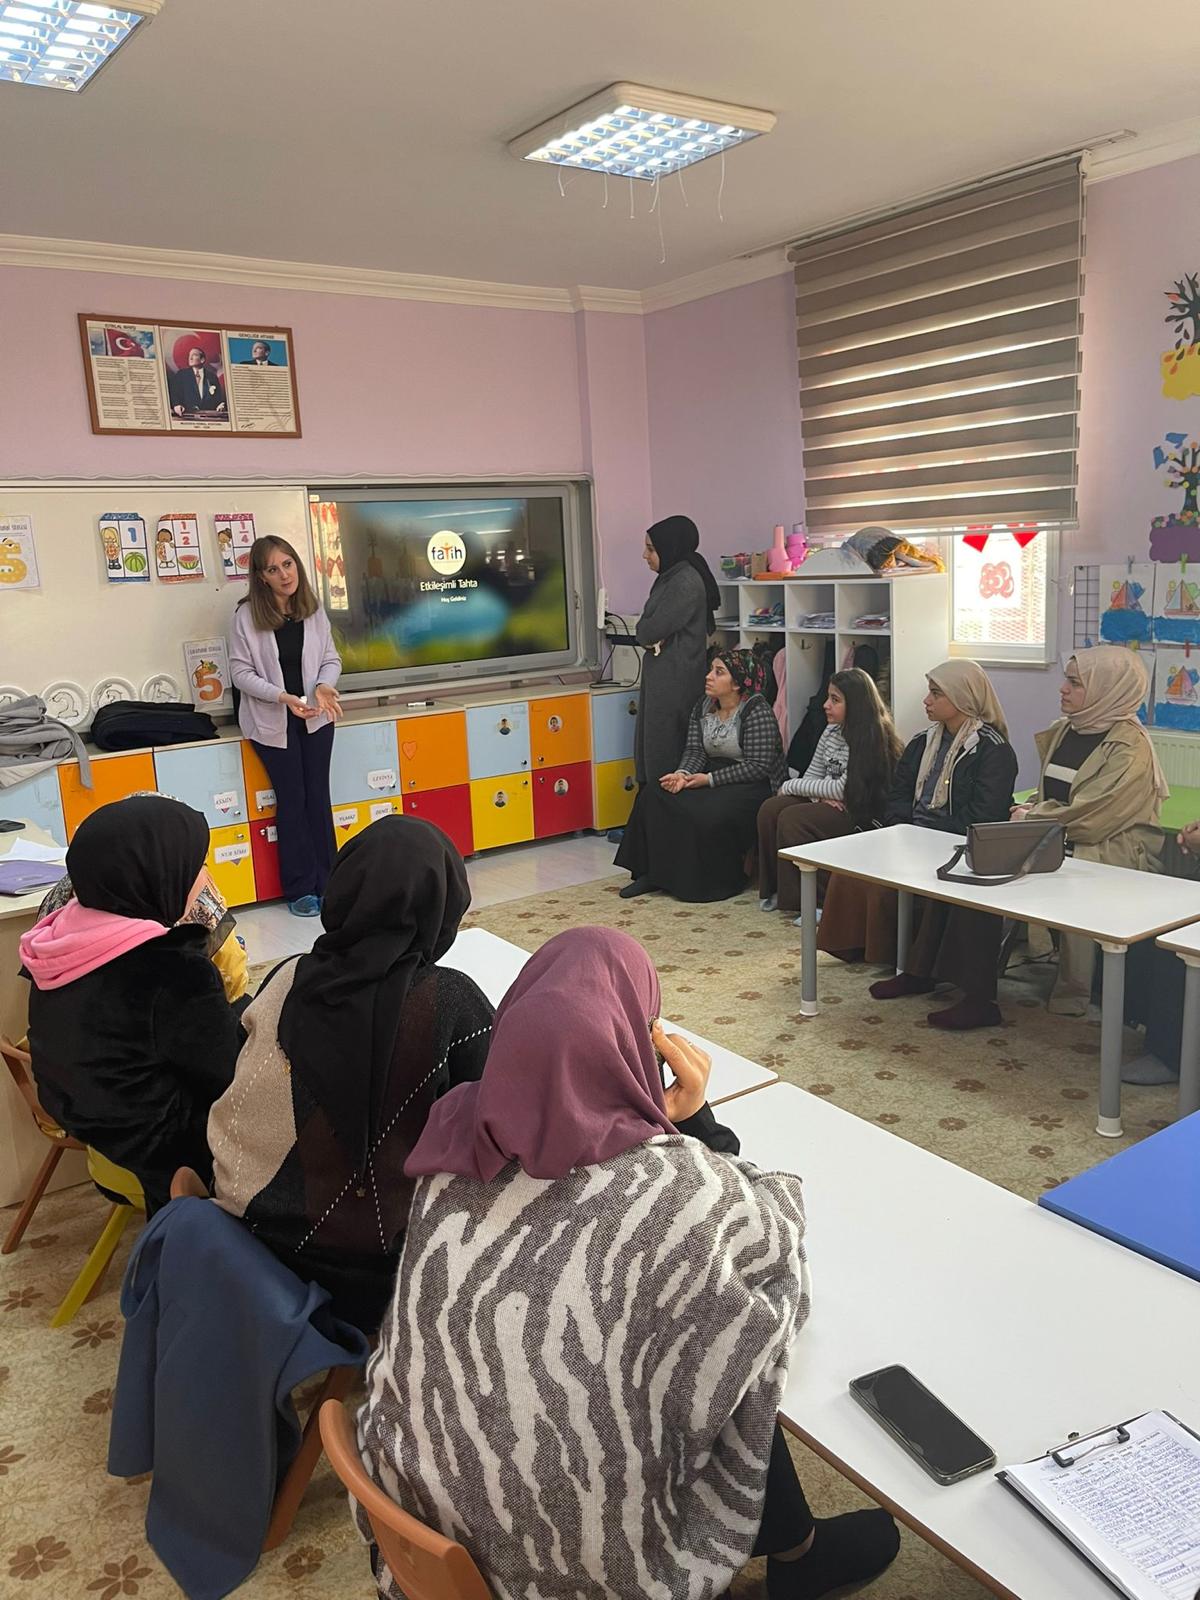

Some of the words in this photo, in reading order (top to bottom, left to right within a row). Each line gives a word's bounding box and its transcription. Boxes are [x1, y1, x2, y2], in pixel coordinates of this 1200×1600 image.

[180, 521, 187, 530] 1
[240, 521, 246, 530] 1
[127, 527, 137, 543] 1
[241, 534, 249, 544] 4
[182, 537, 190, 545] 2
[420, 580, 457, 592] Etkileşimli
[458, 579, 478, 588] Tahta
[193, 668, 223, 701] 5
